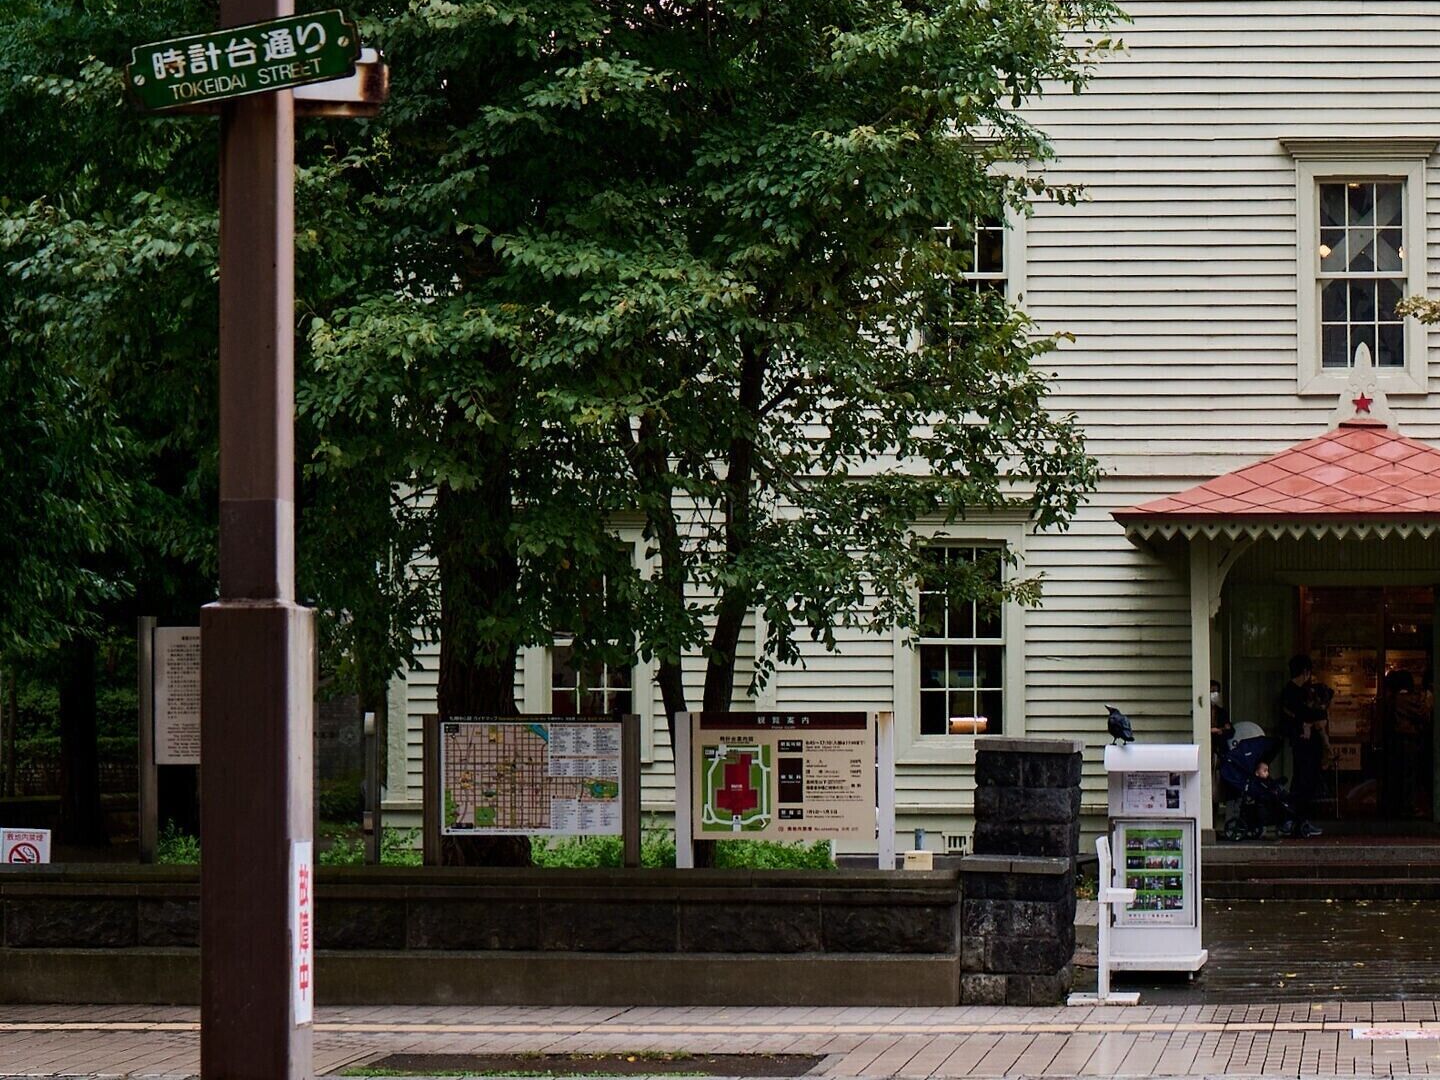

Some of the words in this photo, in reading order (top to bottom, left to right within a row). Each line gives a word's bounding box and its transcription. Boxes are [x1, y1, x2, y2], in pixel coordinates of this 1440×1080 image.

[151, 22, 327, 80] 時計台通り
[168, 73, 247, 100] TOKEIDAI
[257, 57, 322, 85] STREET
